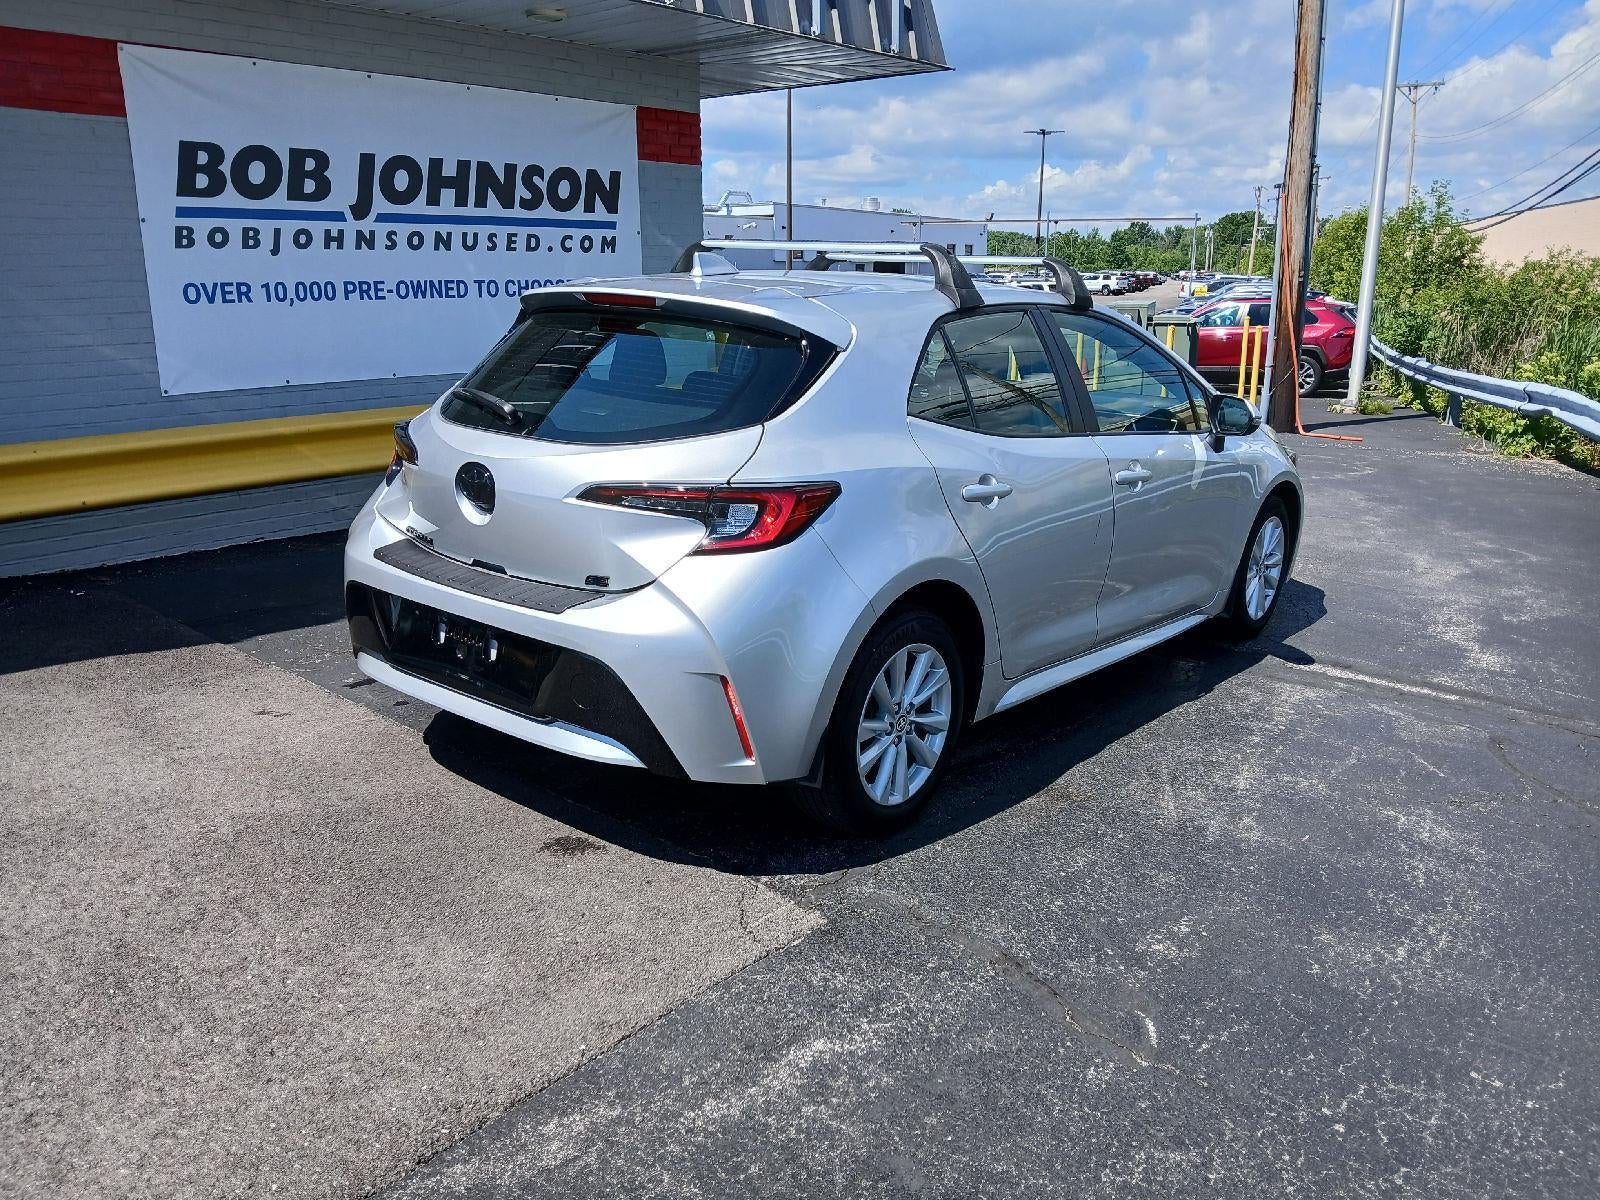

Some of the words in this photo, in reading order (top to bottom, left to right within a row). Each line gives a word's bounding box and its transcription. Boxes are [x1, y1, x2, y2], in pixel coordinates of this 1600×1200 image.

[175, 139, 332, 202] BOB
[347, 152, 622, 222] JOHNSON
[174, 225, 617, 257] BOBJOHNSONUSED.COM
[182, 281, 254, 305] OVER
[260, 280, 337, 307] 10,000
[342, 279, 469, 301] PRE-OWNED
[472, 279, 500, 299] TO
